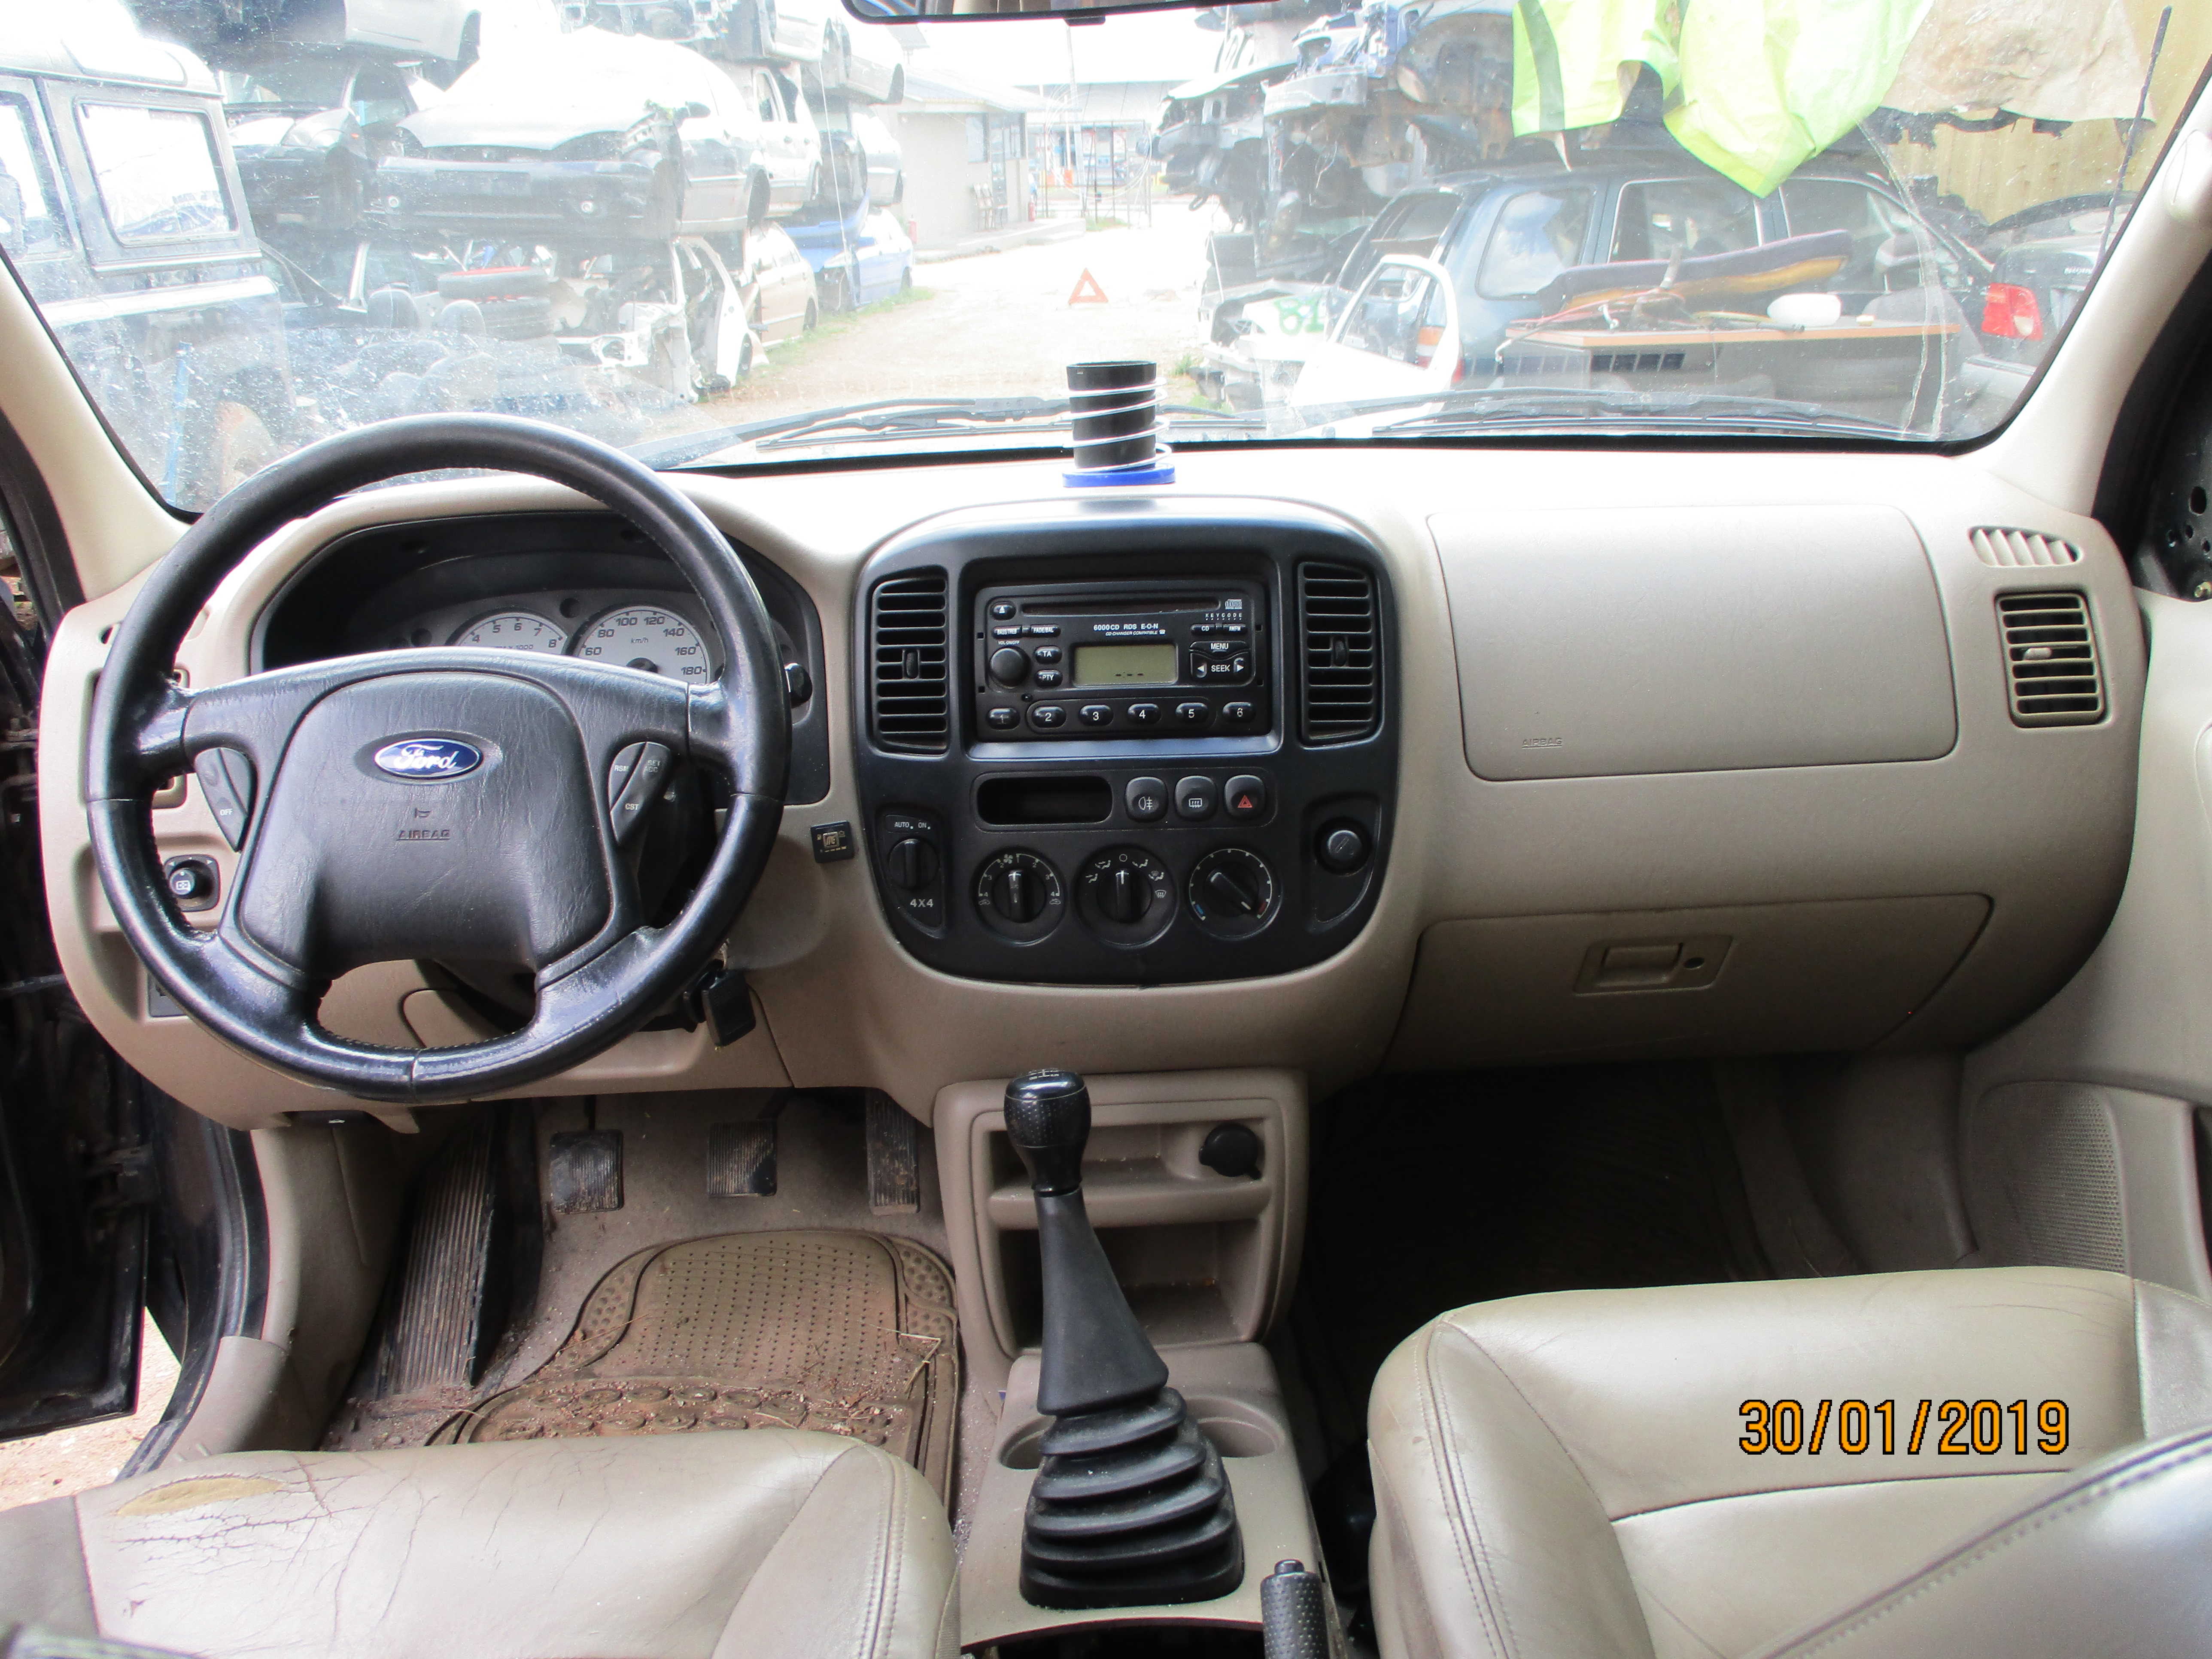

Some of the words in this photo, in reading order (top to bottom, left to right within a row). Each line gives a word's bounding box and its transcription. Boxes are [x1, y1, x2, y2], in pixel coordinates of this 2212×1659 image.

[615, 617, 638, 626] 100
[644, 616, 665, 625] 120
[492, 624, 501, 633] 5
[514, 622, 522, 631] 6
[534, 627, 542, 636] 7
[597, 629, 614, 638] 80
[663, 628, 685, 637] 140
[473, 634, 480, 643] 4
[548, 639, 557, 647] 8
[585, 647, 602, 656] 60
[675, 646, 696, 656] 160
[681, 666, 702, 675] 180
[1211, 664, 1231, 672] SEEK
[1045, 712, 1051, 721] 2
[1092, 711, 1099, 721] 3
[1139, 709, 1146, 719] 4
[1188, 708, 1195, 718] 5
[1237, 708, 1243, 717] 6
[394, 744, 460, 769] Ford
[398, 829, 450, 839] AIRBAG
[910, 898, 934, 908] 4X4
